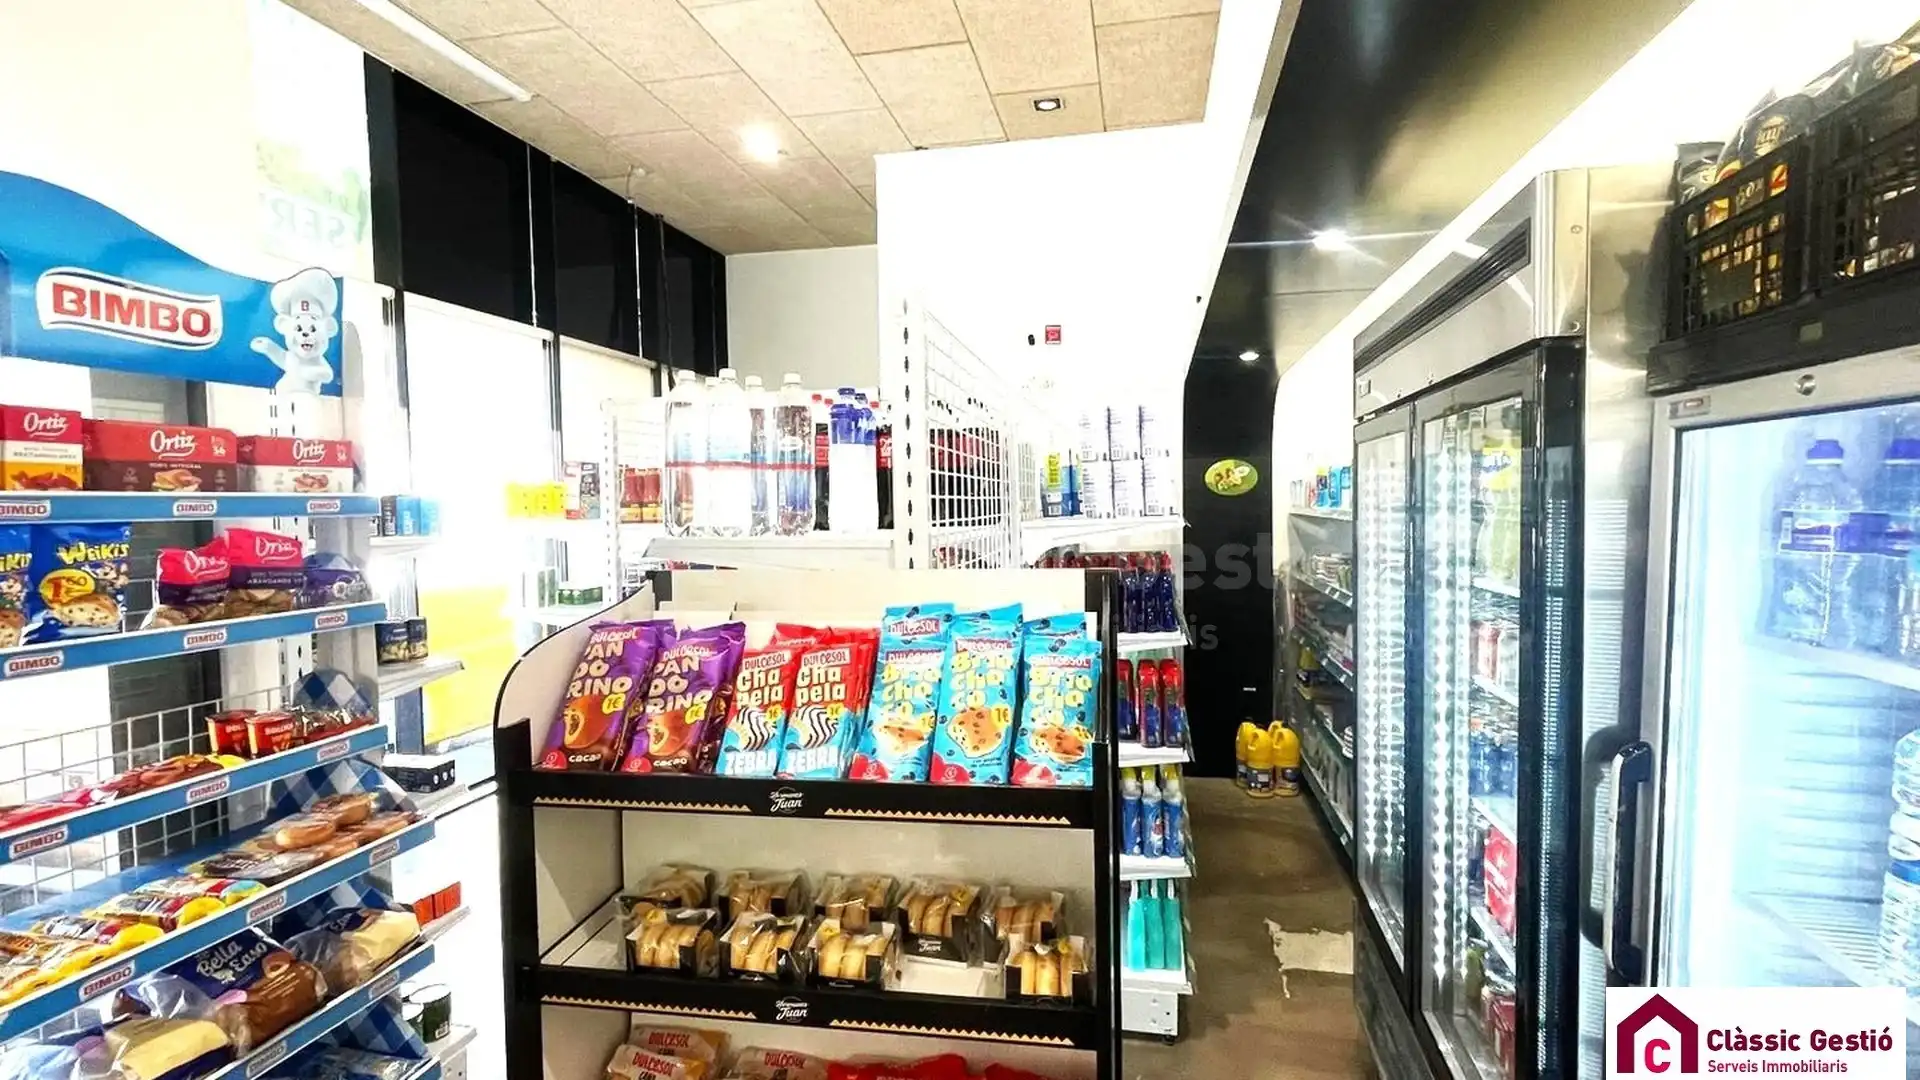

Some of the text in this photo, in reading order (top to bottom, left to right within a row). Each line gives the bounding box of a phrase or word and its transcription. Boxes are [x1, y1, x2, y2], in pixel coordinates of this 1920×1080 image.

[52, 282, 212, 338] BIMBO
[24, 412, 68, 438] Ortiz
[150, 430, 197, 458] Ortiz
[293, 440, 325, 463] Ortiz
[9, 655, 60, 672] BIMBO
[744, 654, 788, 670] DULCESOL
[803, 651, 847, 667] DULCESOL
[566, 676, 633, 698] RINO
[648, 674, 689, 697] DO
[736, 668, 781, 692] Cha
[796, 666, 842, 688] Cha
[645, 689, 713, 714] RINO
[735, 686, 784, 709] pela
[795, 683, 846, 707] pela
[995, 707, 1009, 723] 1€
[770, 799, 803, 813] Juan
[14, 830, 66, 854] BIMBO
[197, 941, 243, 977] Bella
[229, 941, 268, 972] Easo
[83, 965, 132, 998] BIMBO
[775, 1008, 808, 1021] Juan
